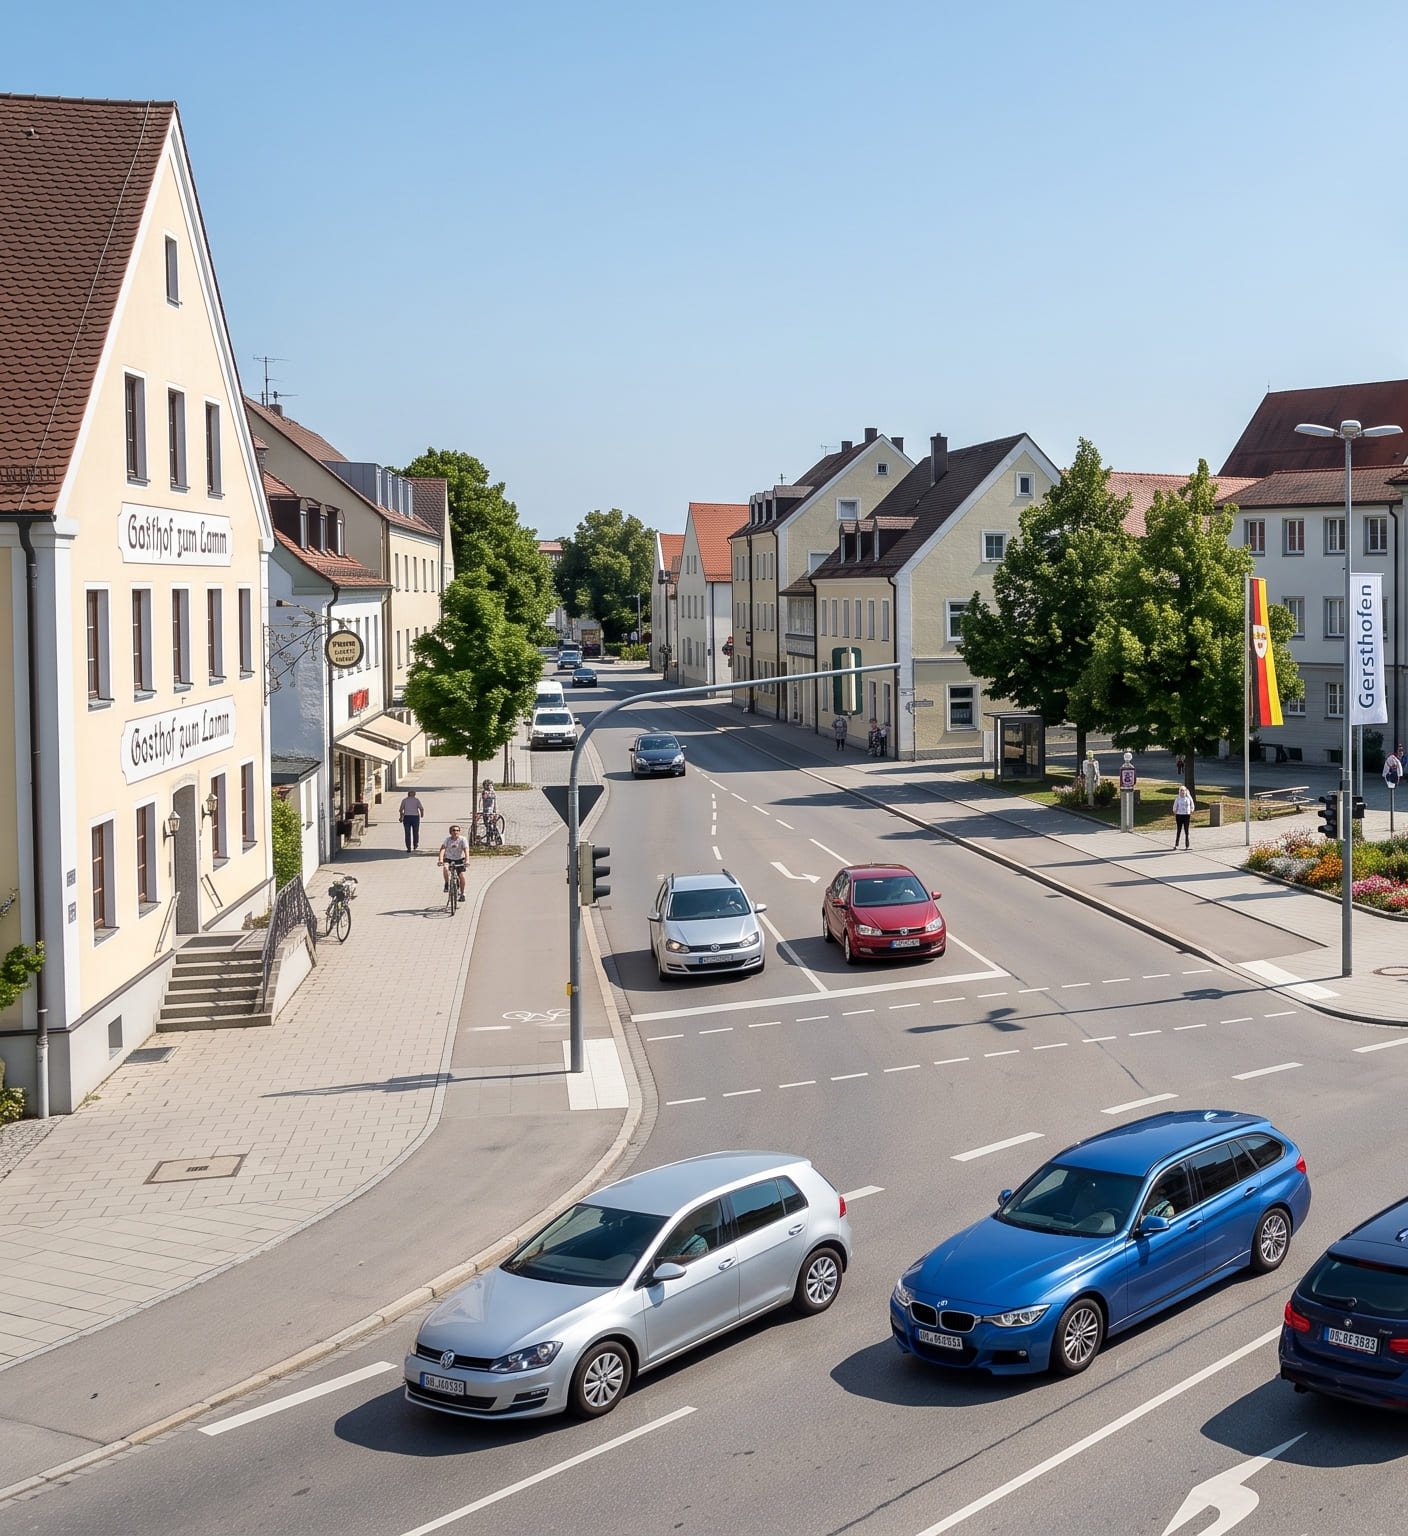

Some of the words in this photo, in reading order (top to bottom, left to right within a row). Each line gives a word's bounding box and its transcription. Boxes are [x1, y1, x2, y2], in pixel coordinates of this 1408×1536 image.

[177, 528, 198, 558] zum
[1357, 584, 1375, 709] Gersthofen
[180, 722, 199, 759] zum
